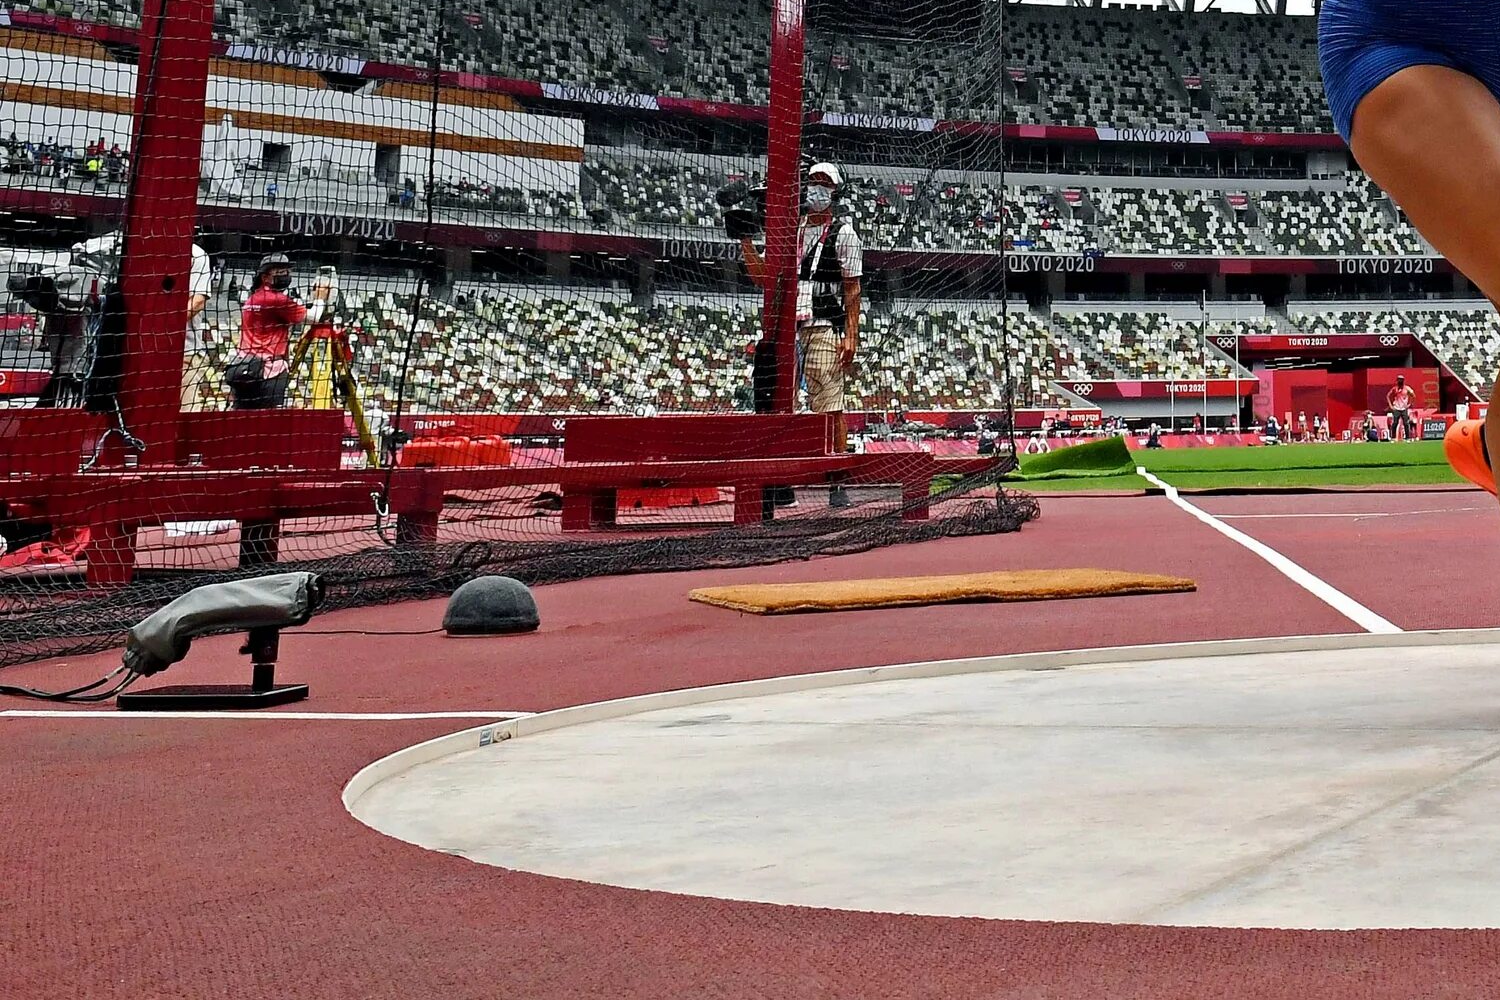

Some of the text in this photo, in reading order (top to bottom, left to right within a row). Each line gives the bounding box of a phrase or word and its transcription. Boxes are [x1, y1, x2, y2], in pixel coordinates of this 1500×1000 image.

[252, 44, 343, 70] TOKYO 2020
[1115, 129, 1191, 143] TOKYO 2020
[718, 243, 745, 260] 202
[1008, 255, 1094, 272] OKYO 2020
[1336, 259, 1433, 274] TOKYO 2020
[1287, 338, 1328, 346] TOKYO 2020
[1165, 384, 1188, 392] TOKYO
